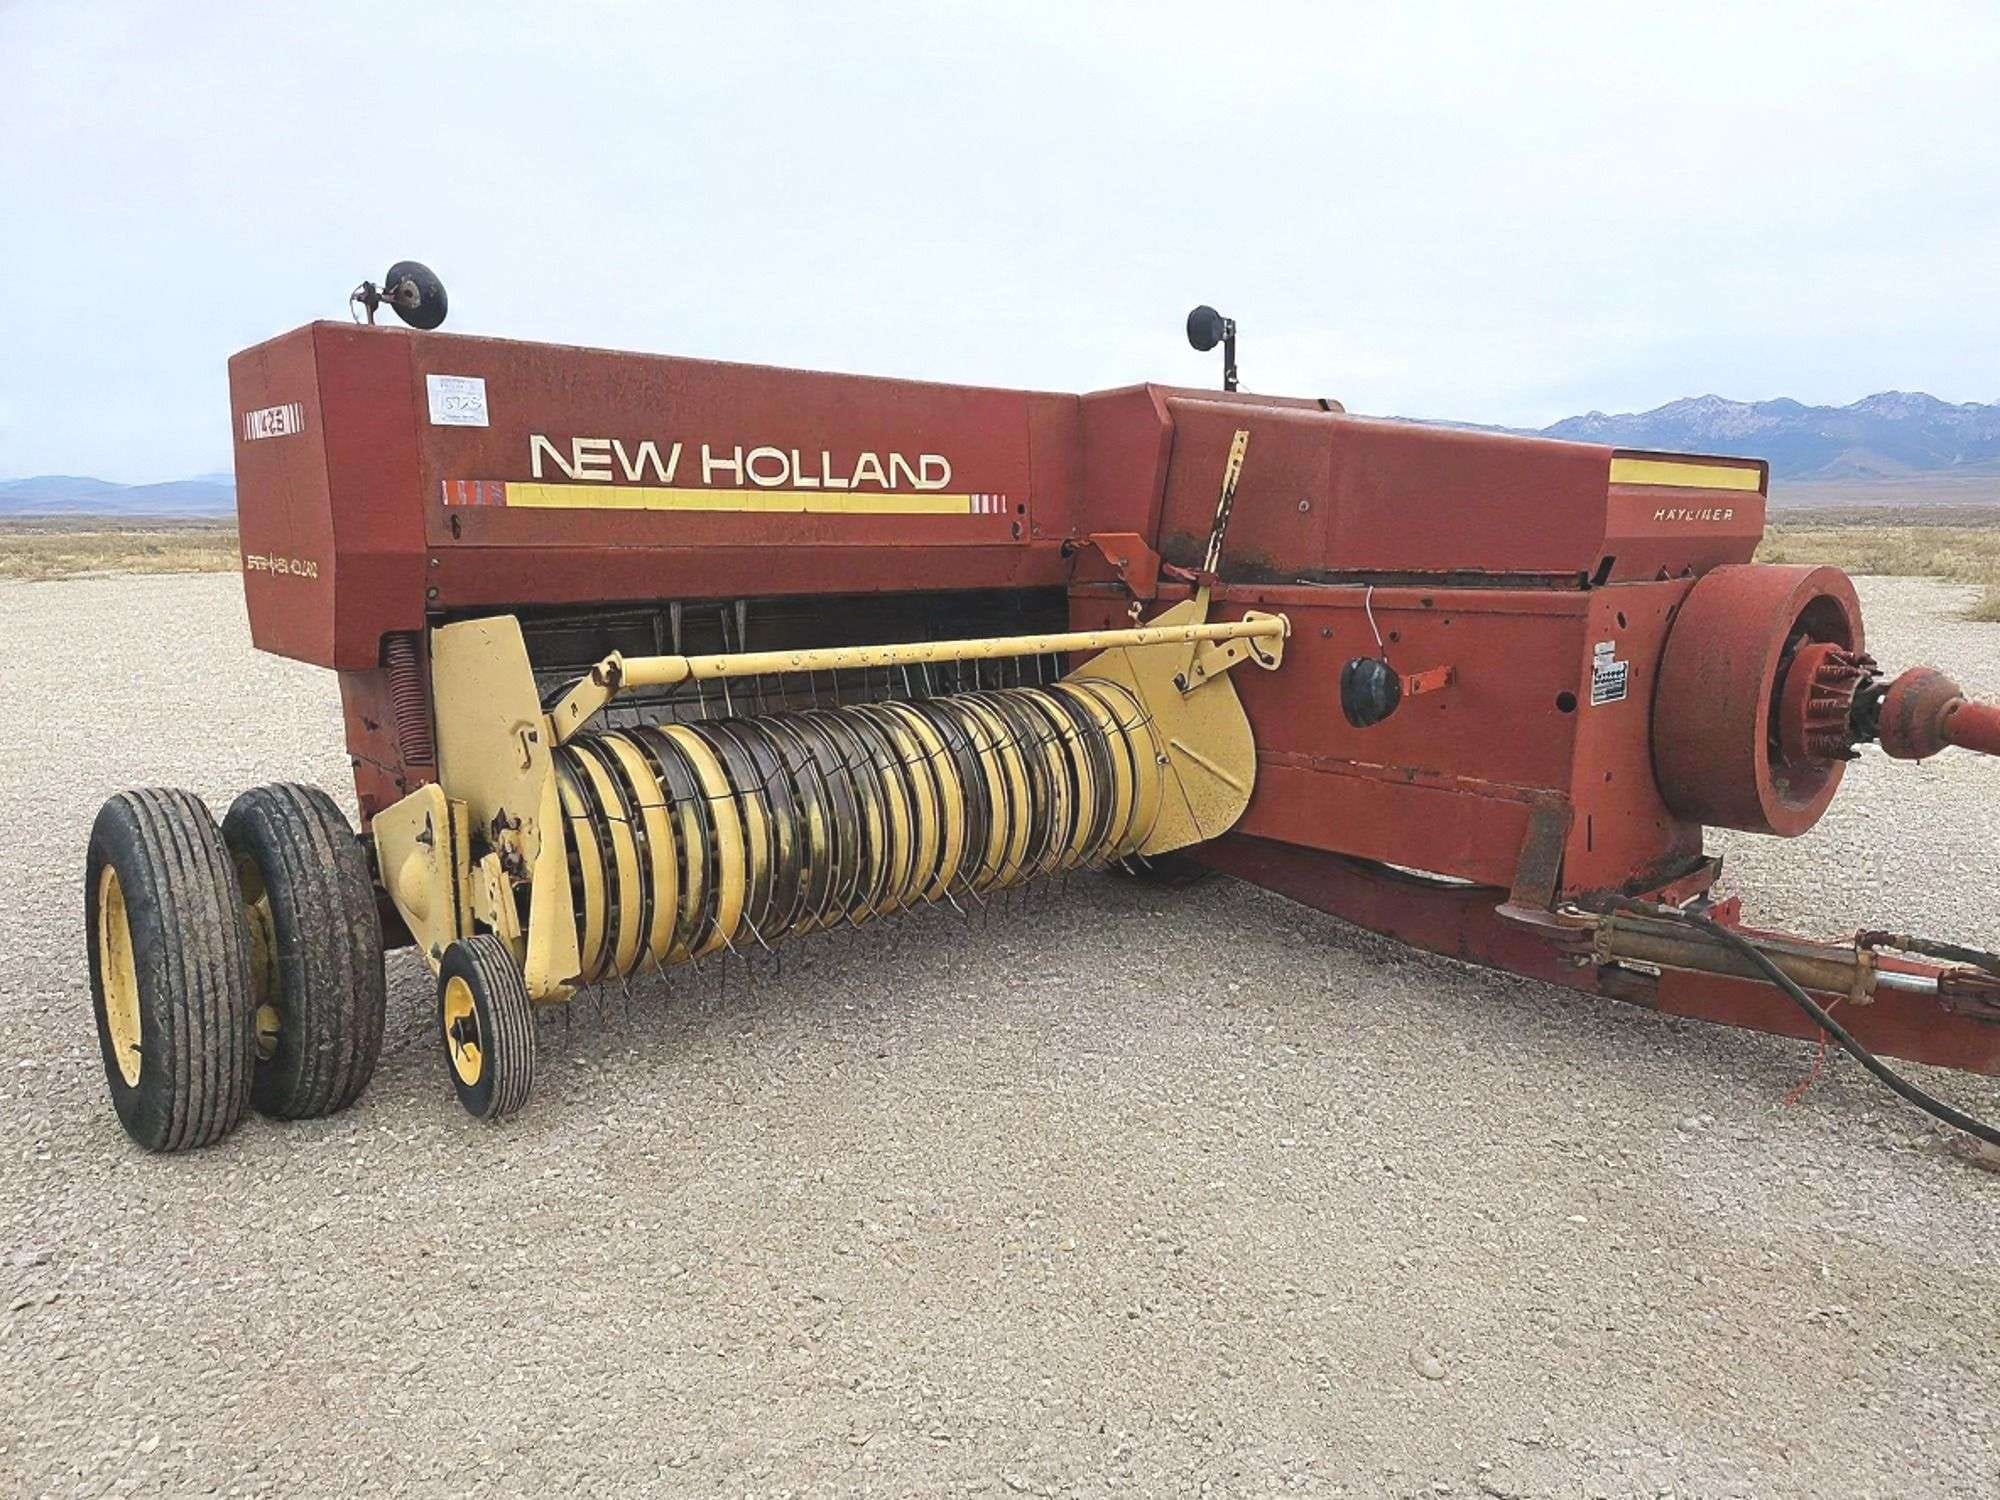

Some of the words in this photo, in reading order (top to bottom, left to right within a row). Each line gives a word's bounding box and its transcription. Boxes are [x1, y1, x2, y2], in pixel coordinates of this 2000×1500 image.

[530, 434, 682, 483] NEW
[702, 444, 951, 490] HOLLAND
[1654, 508, 1734, 521] HAYLINER
